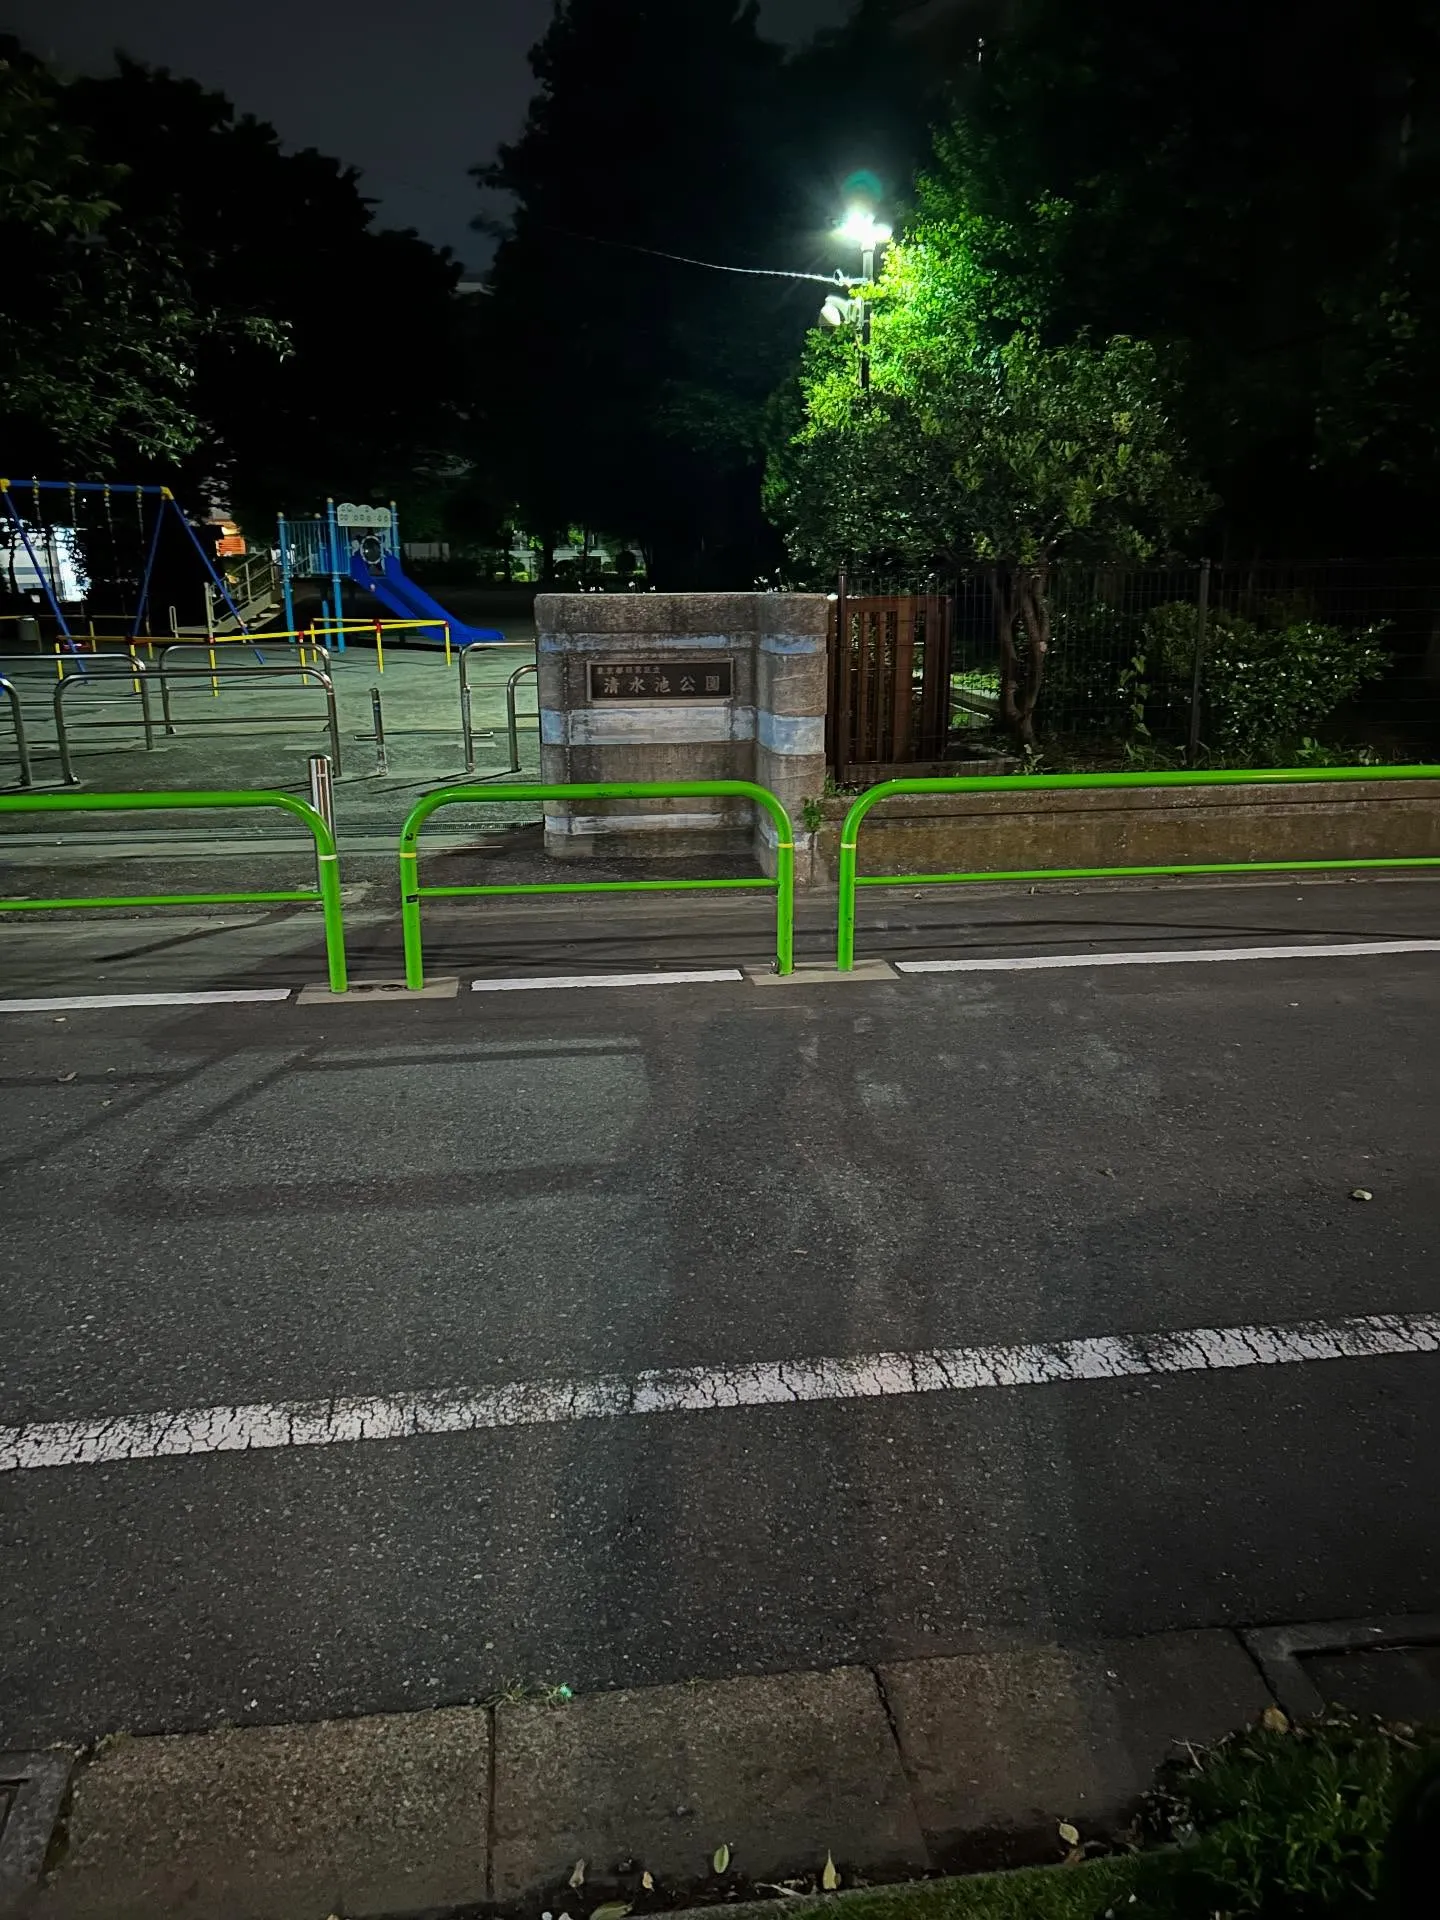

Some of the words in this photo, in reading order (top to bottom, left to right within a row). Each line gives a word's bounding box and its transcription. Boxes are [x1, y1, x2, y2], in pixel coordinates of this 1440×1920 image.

[604, 675, 720, 694] 清水池公園
